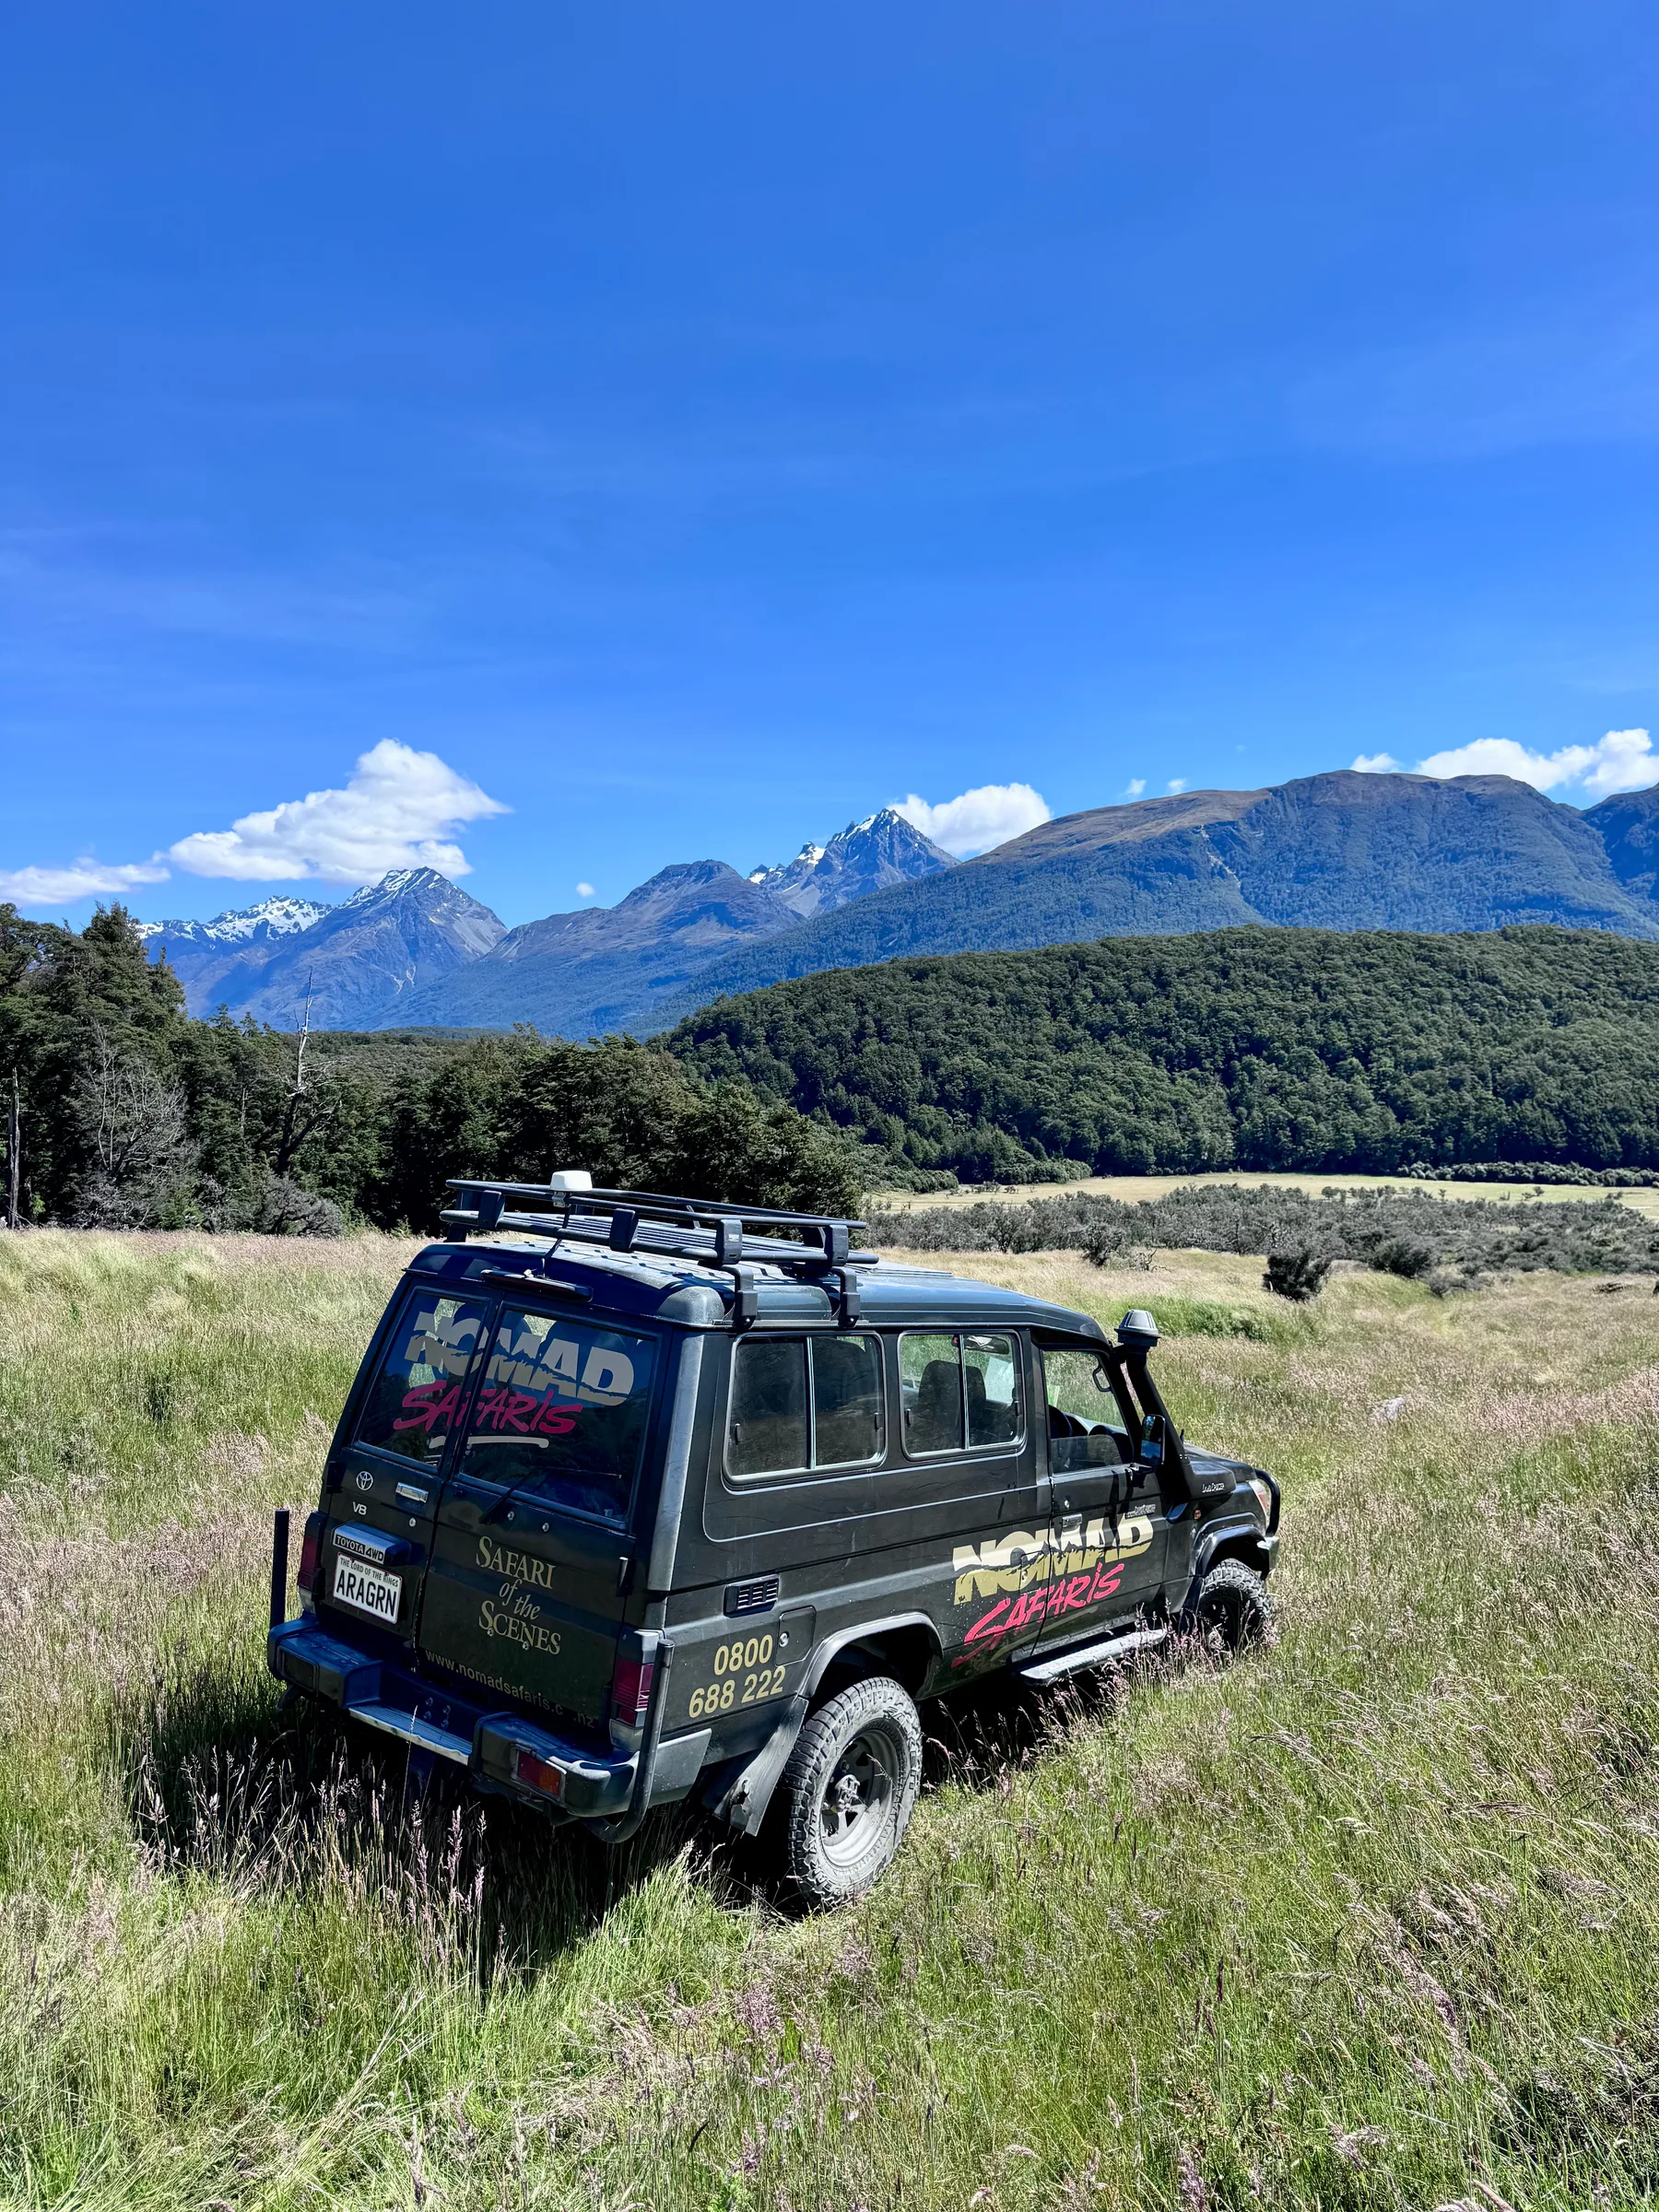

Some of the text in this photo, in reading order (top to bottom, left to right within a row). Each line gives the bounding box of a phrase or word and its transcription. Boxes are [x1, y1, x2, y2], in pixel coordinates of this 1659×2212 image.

[404, 1311, 635, 1406] NOMAD
[394, 1380, 583, 1434] SAFARIS
[352, 1501, 367, 1516] V8
[336, 1535, 384, 1562] TOYOTA 4WD
[340, 1558, 350, 1568] THE
[350, 1559, 364, 1574] LORD
[364, 1568, 371, 1576] OF
[371, 1570, 382, 1582] THE
[476, 1535, 556, 1590] SAFARI
[953, 1514, 1154, 1605] NOMAD
[335, 1570, 397, 1618] ARAGRN
[499, 1578, 541, 1620] of the
[951, 1562, 1124, 1668] SAFARIS
[478, 1600, 561, 1655] SCENES
[714, 1634, 773, 1676] 0800
[425, 1649, 595, 1729] www.nomadsafaris.c.nz
[688, 1665, 786, 1719] 688 222
